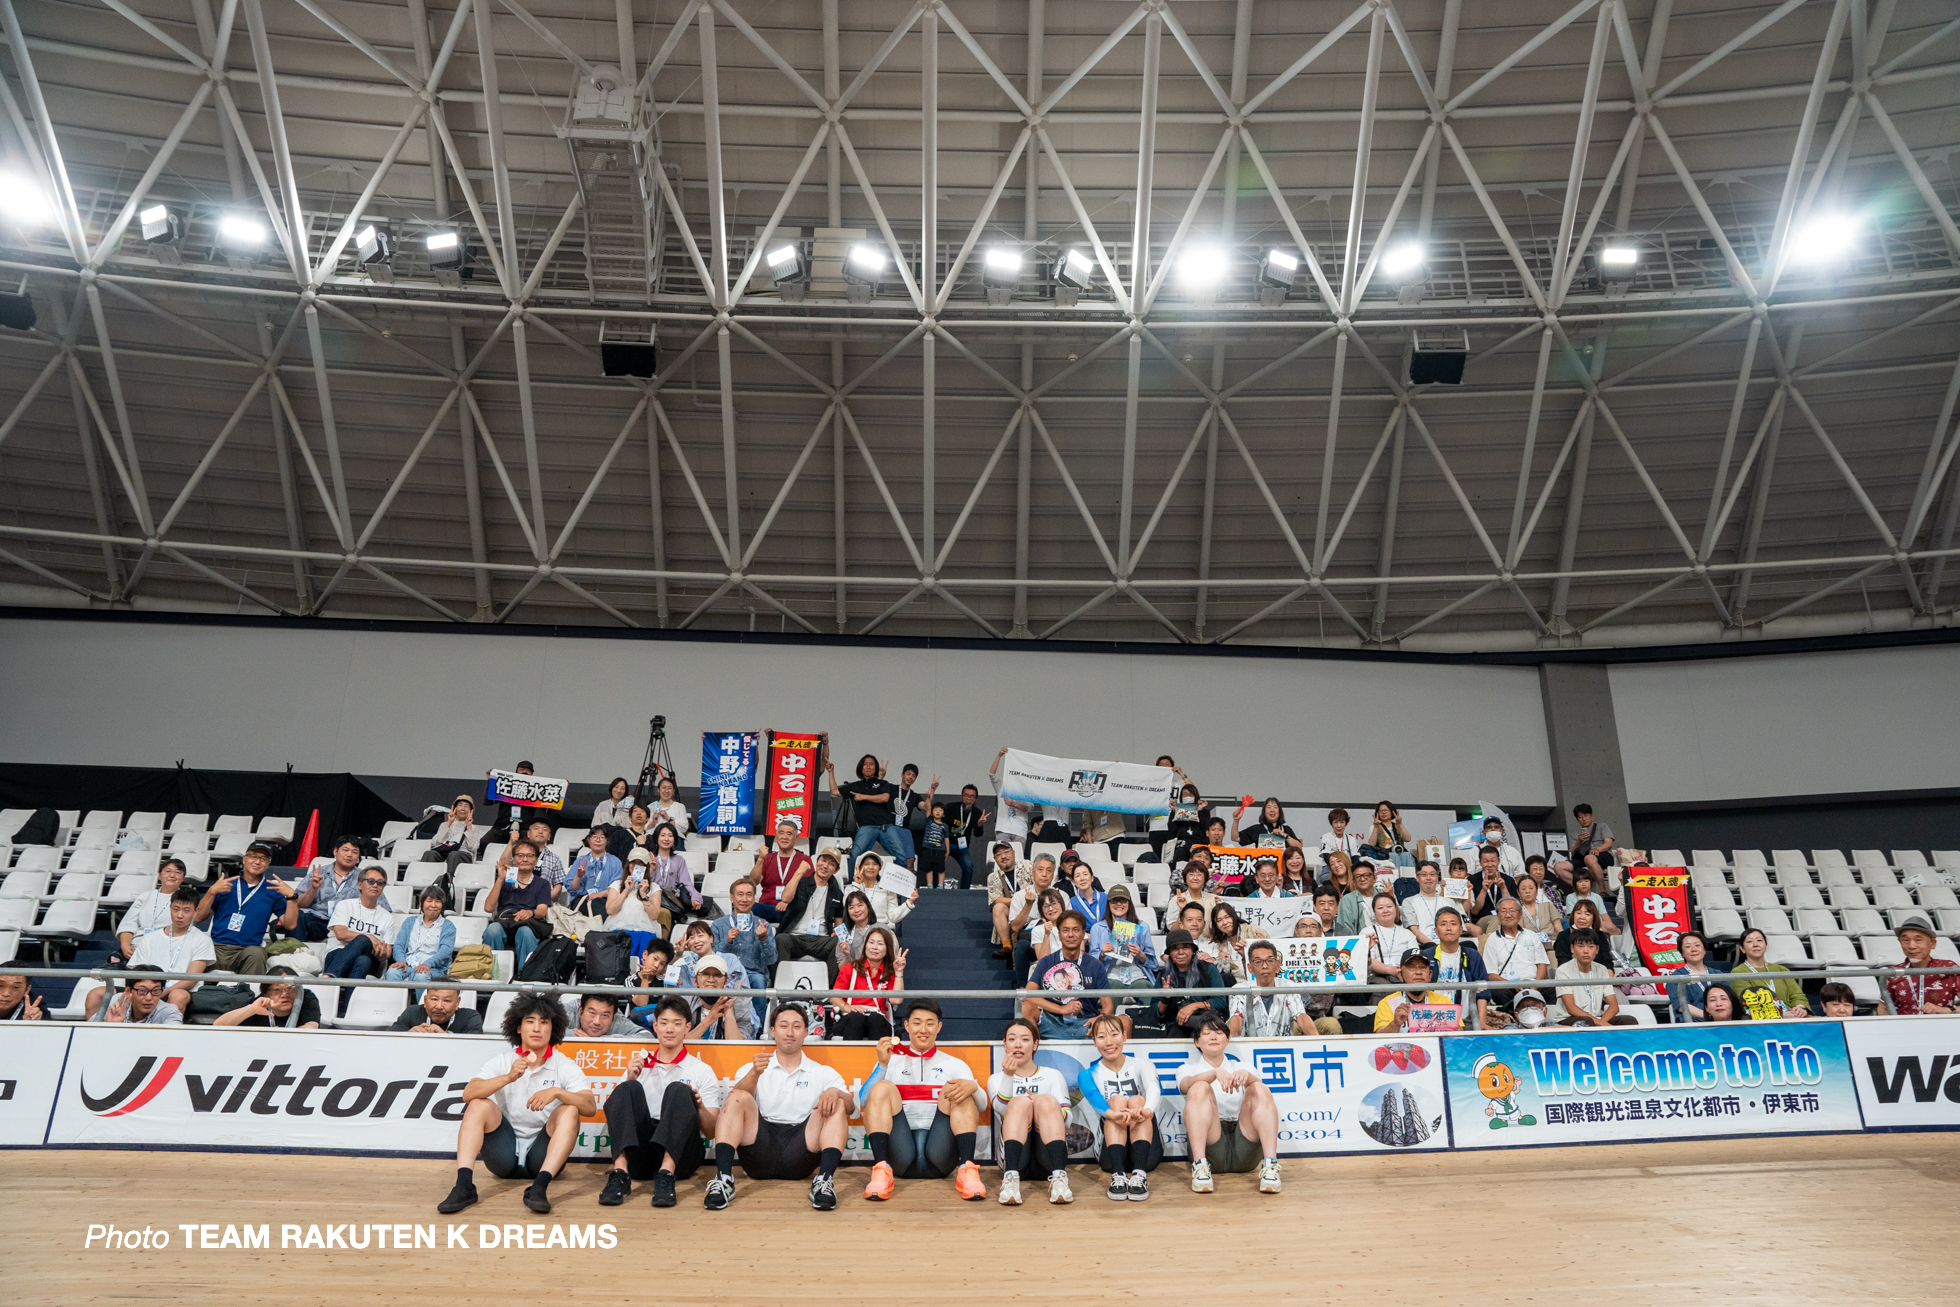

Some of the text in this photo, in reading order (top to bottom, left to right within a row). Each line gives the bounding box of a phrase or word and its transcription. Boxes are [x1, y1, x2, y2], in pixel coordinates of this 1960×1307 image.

[1020, 772, 1041, 781] RAKUTEN
[495, 778, 561, 803] 佐藤水菜
[706, 825, 747, 833] IWATE 121th
[348, 916, 381, 937] FOTL
[1285, 959, 1322, 967] DREAMS
[1742, 987, 1774, 1006] 全力
[1410, 1008, 1457, 1021] 佐藤水菜
[1529, 1039, 1822, 1096] Welcome to Ito
[184, 1059, 467, 1121] vittoria
[1545, 1092, 1820, 1125] 国際観光温泉文化都市・伊東市
